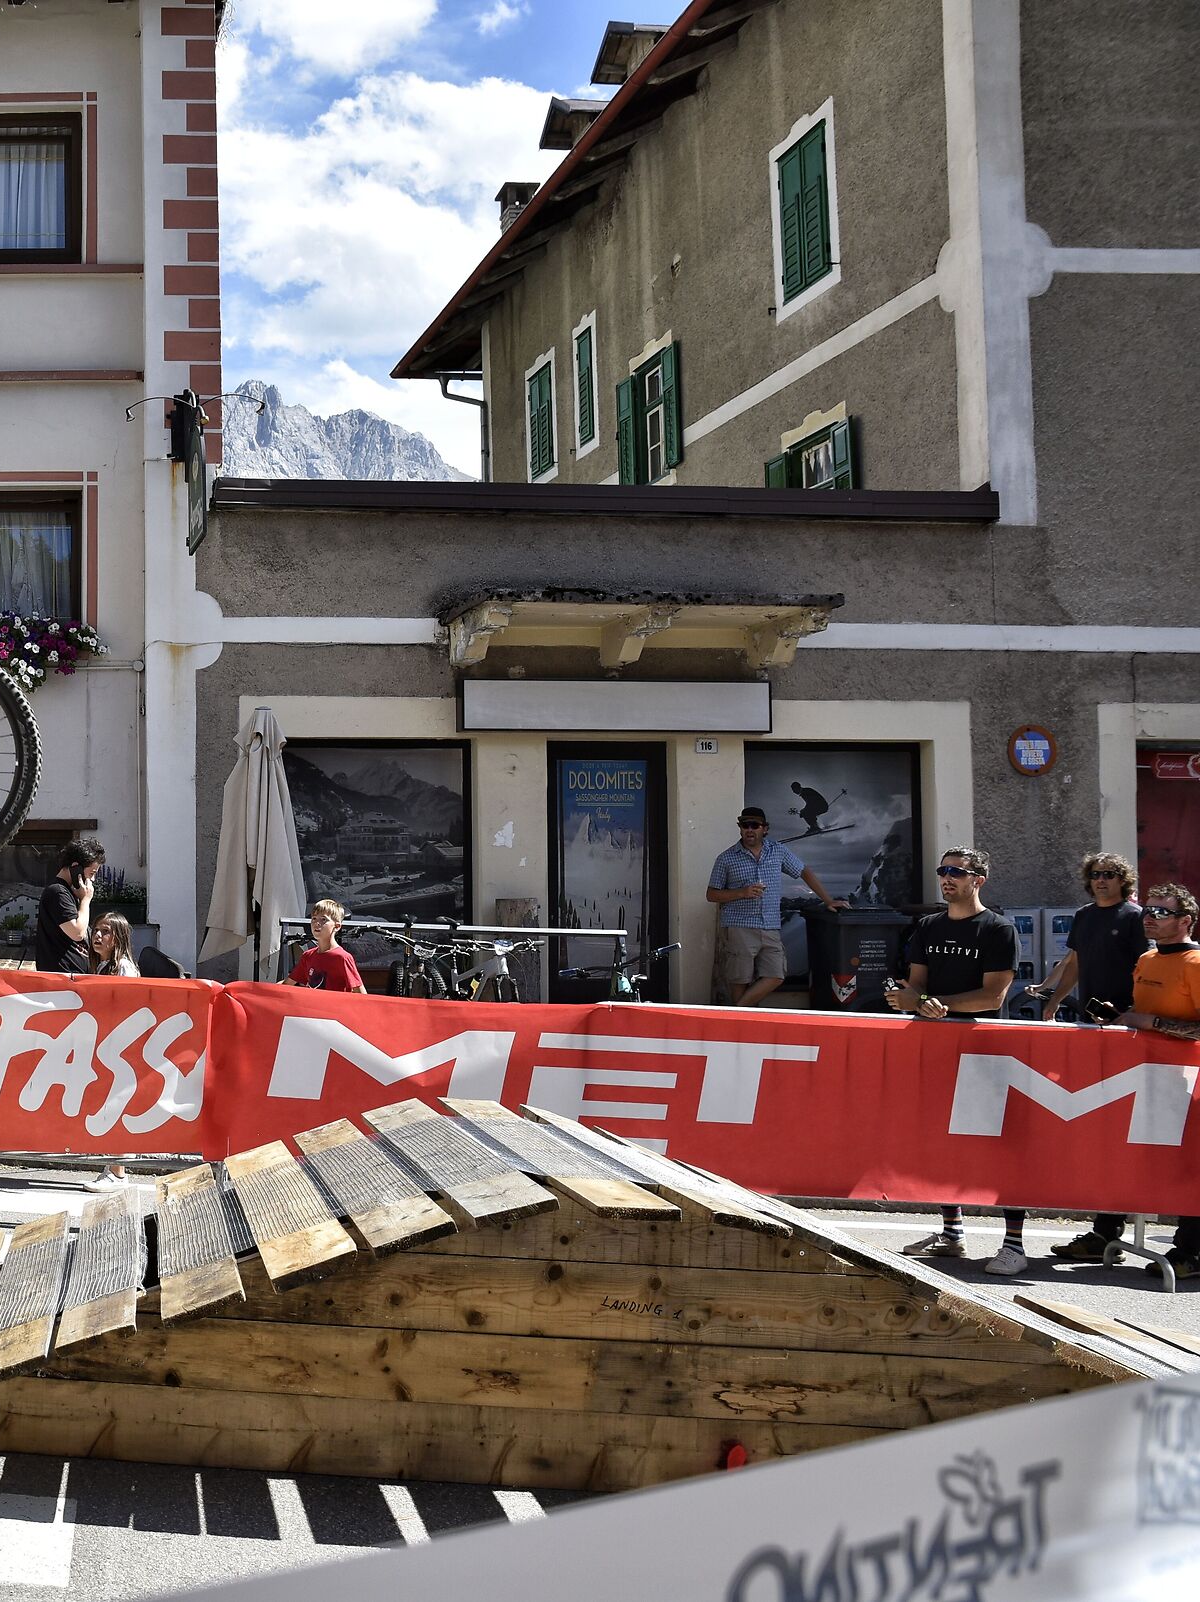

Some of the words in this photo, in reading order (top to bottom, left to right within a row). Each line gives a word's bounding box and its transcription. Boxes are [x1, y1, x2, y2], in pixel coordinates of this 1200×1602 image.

[700, 741, 712, 751] 116
[569, 771, 643, 790] DOLOMITES
[267, 1016, 820, 1156] MET
[601, 1295, 663, 1316] LANDING
